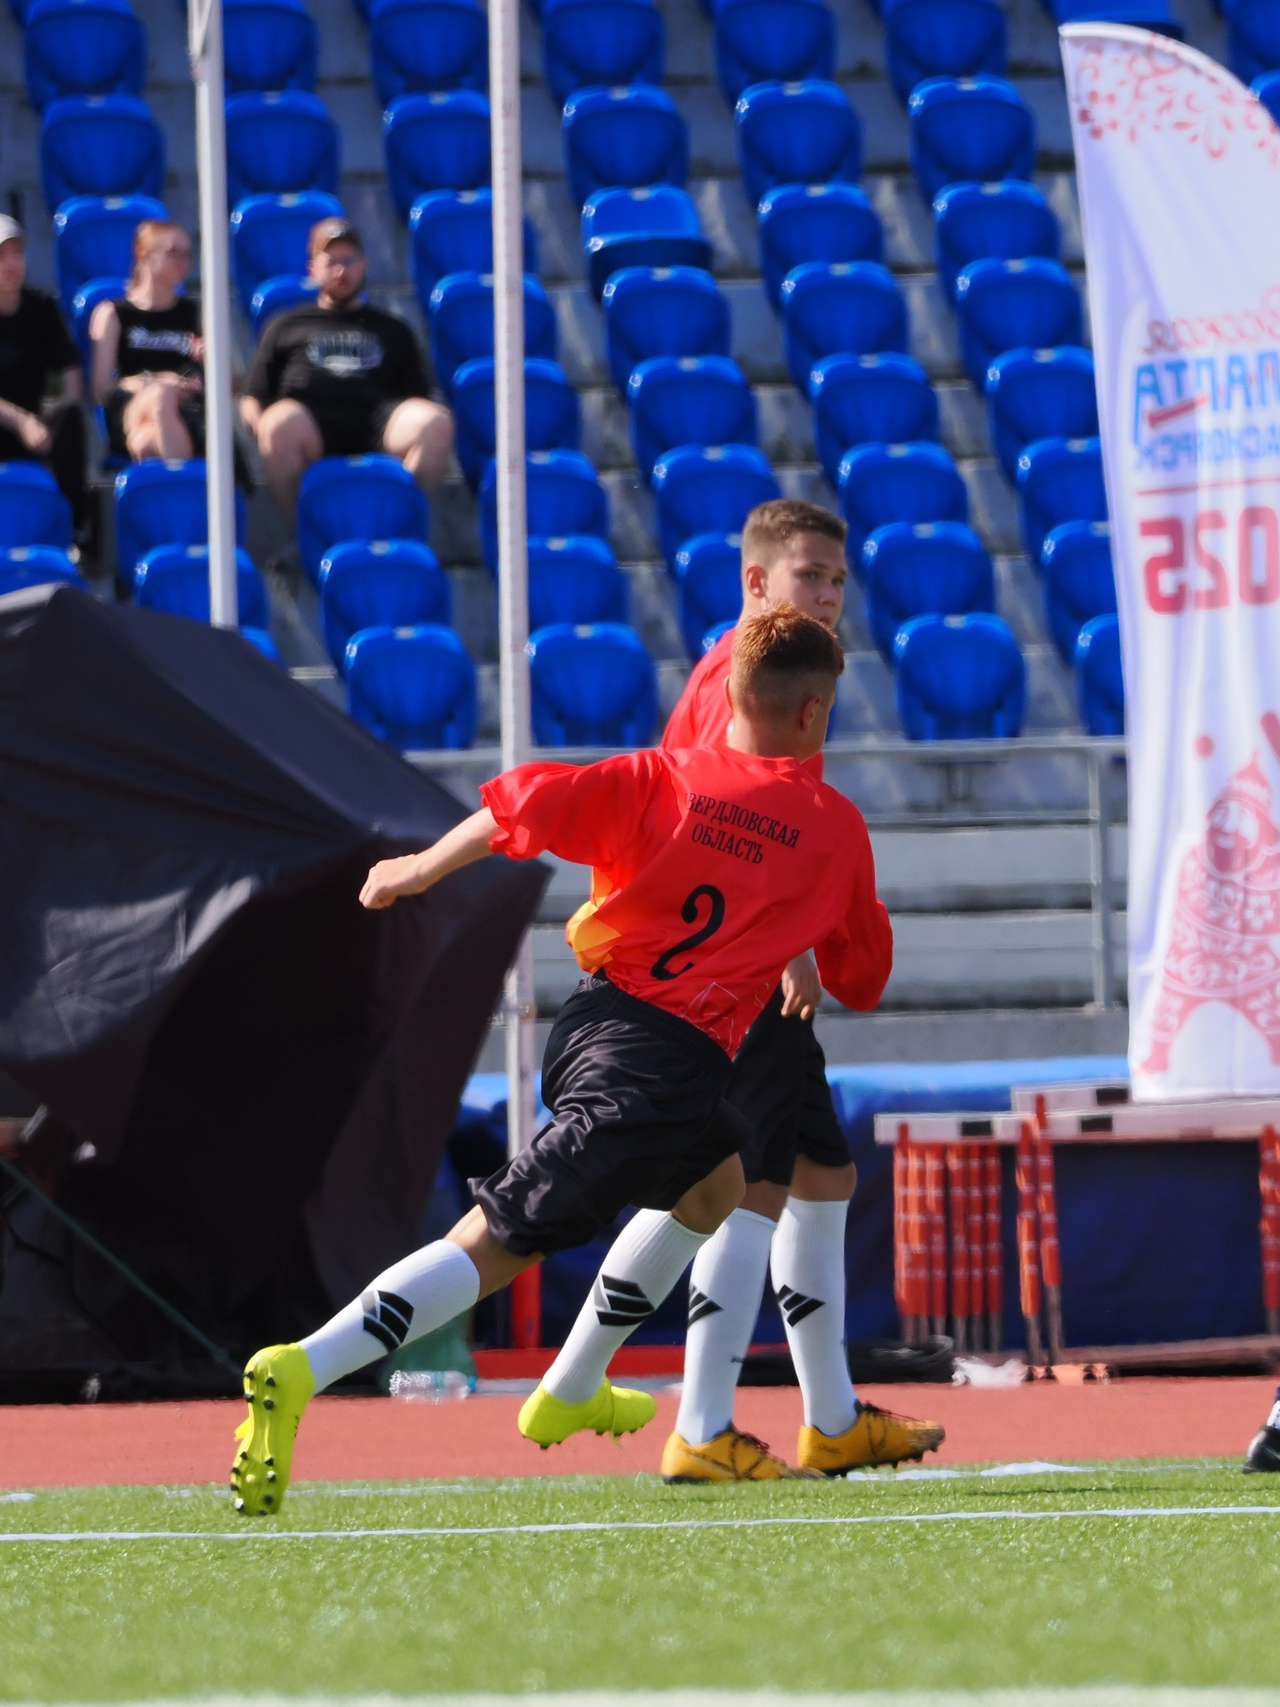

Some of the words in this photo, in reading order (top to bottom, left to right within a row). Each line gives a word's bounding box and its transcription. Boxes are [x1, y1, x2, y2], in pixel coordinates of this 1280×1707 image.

[686, 792, 801, 849] ВЕРДЛОВСКАЯ
[692, 823, 764, 865] ОБЛАСТЬ
[650, 884, 725, 981] 2
